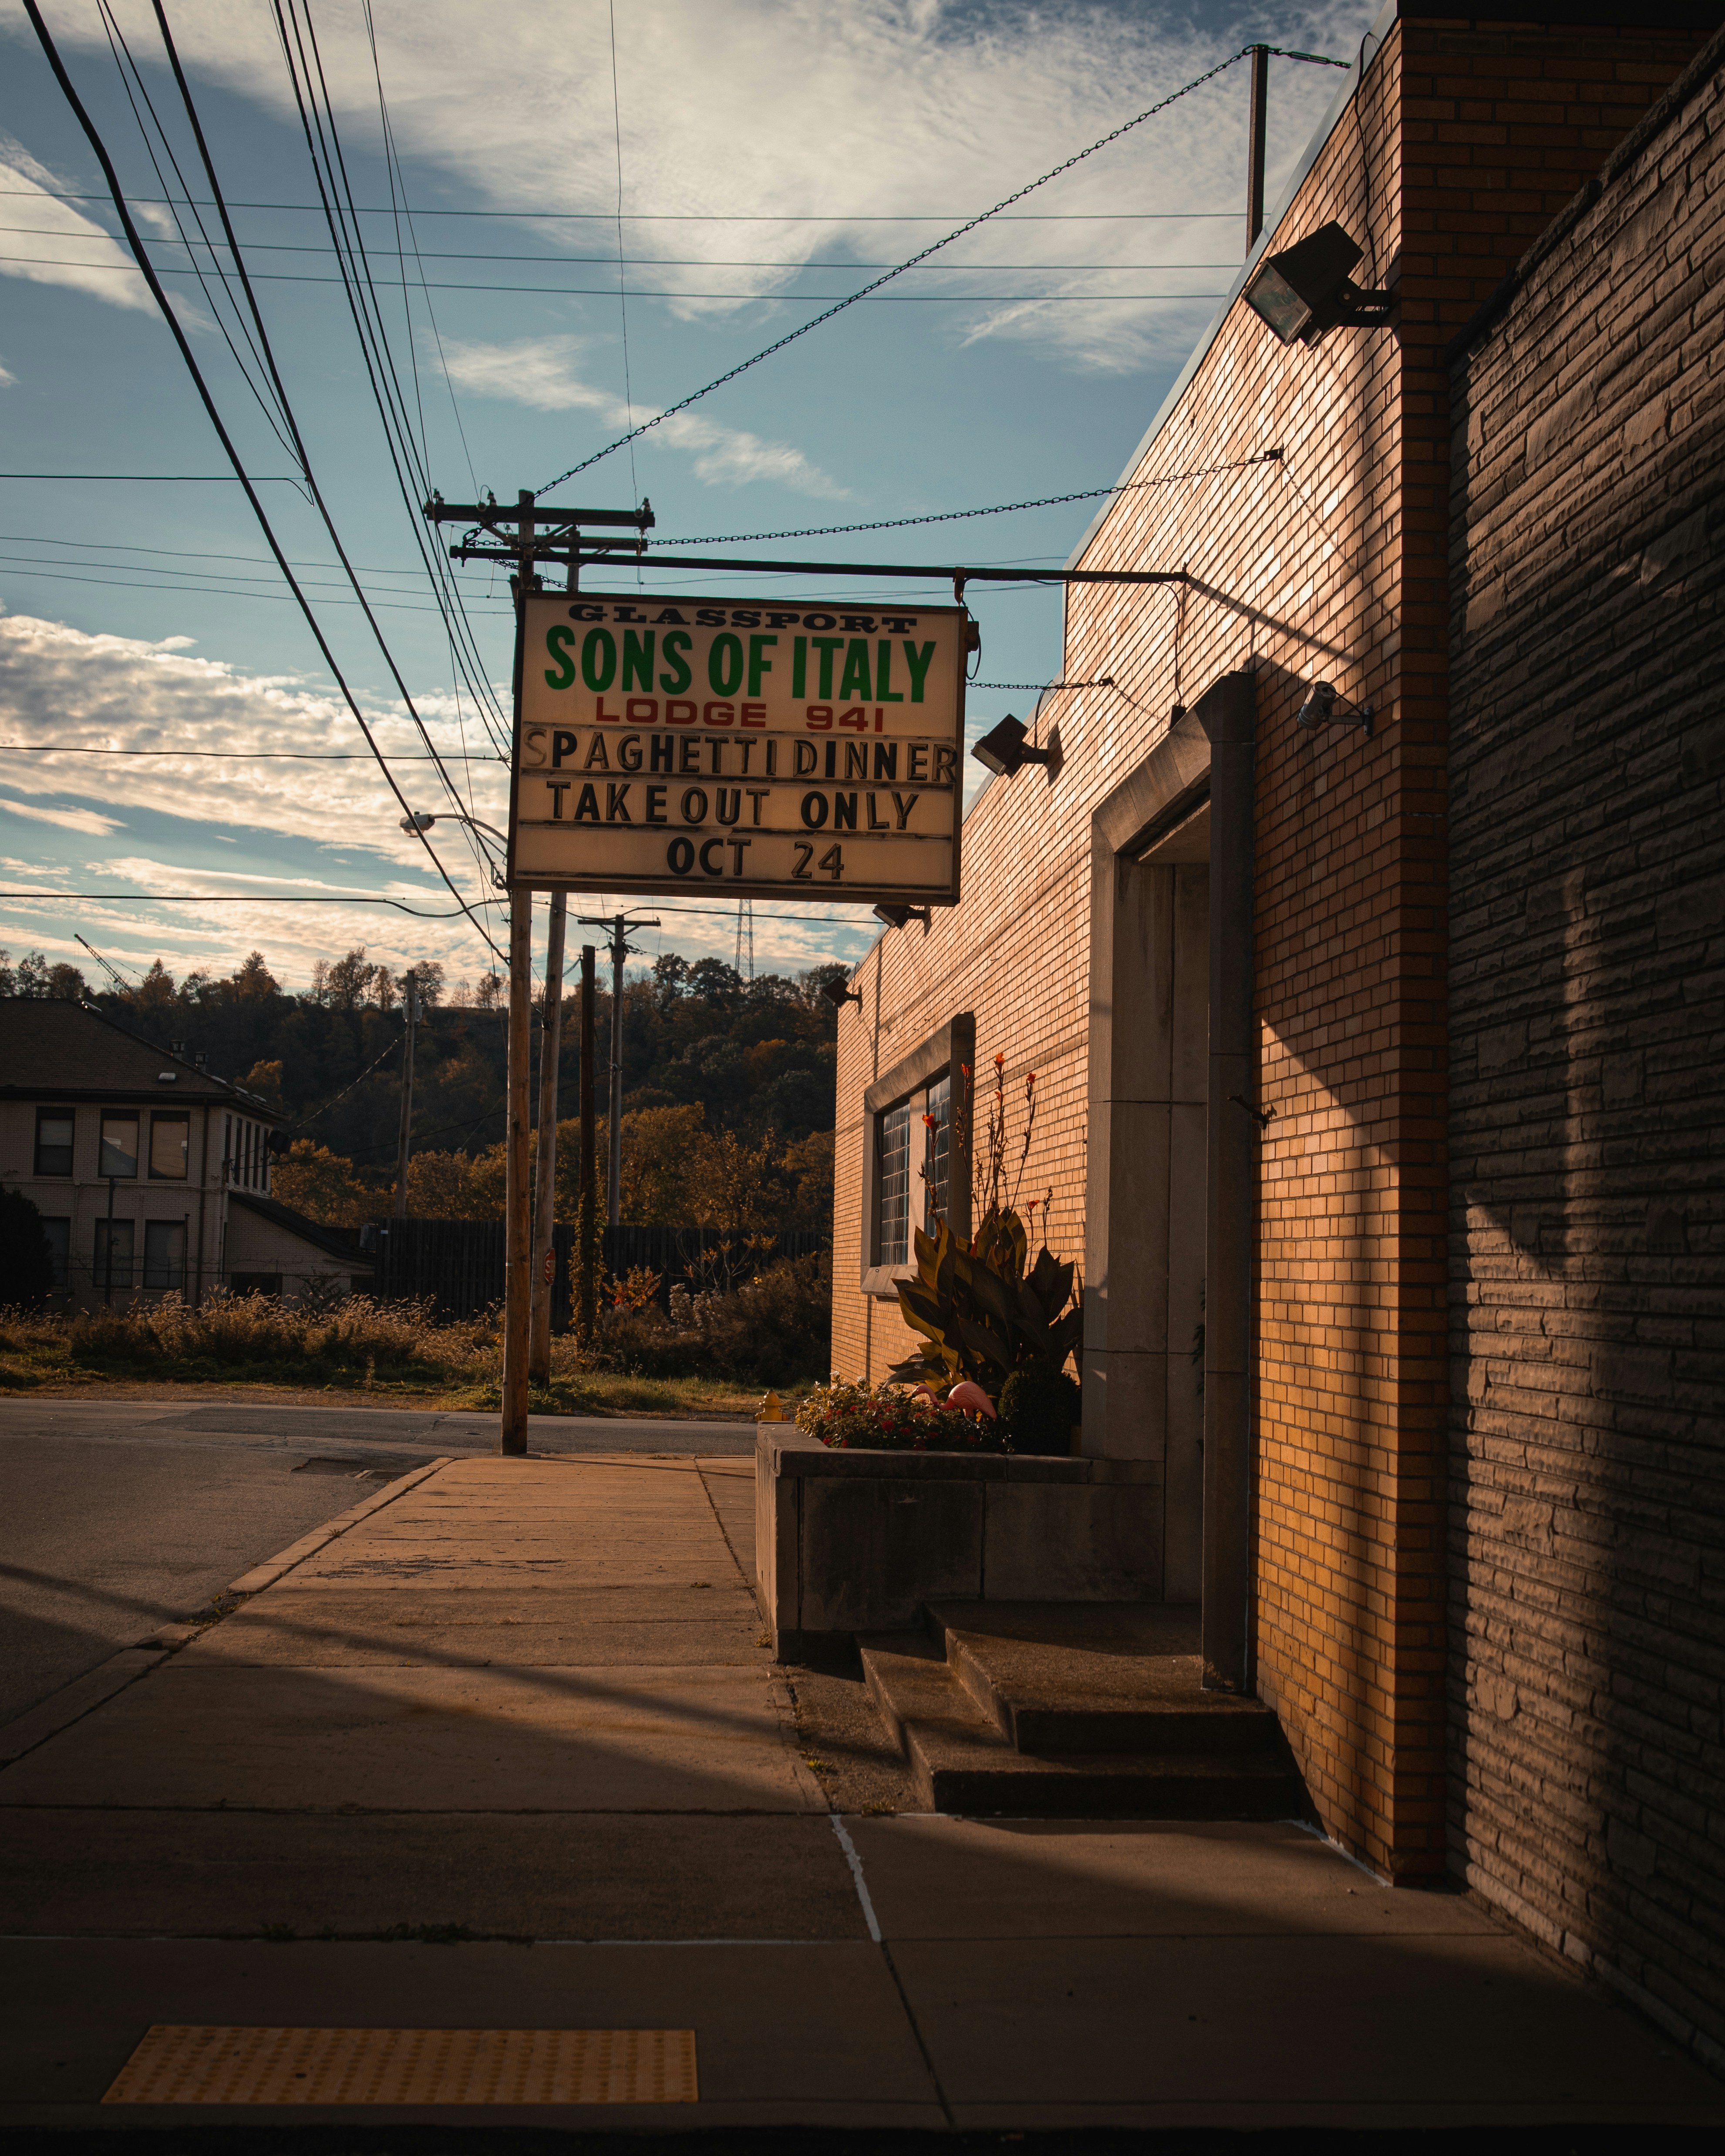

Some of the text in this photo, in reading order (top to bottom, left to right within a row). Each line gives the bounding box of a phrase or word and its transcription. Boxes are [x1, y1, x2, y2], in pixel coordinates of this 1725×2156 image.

[569, 604, 917, 634] GLASSPORT
[544, 625, 937, 703] SONS OF ITALY
[596, 696, 883, 733] LODGE 941
[523, 727, 958, 783] SPAGHETTI DINNER
[801, 790, 919, 830] ONLY
[667, 836, 844, 880] OCT 24
